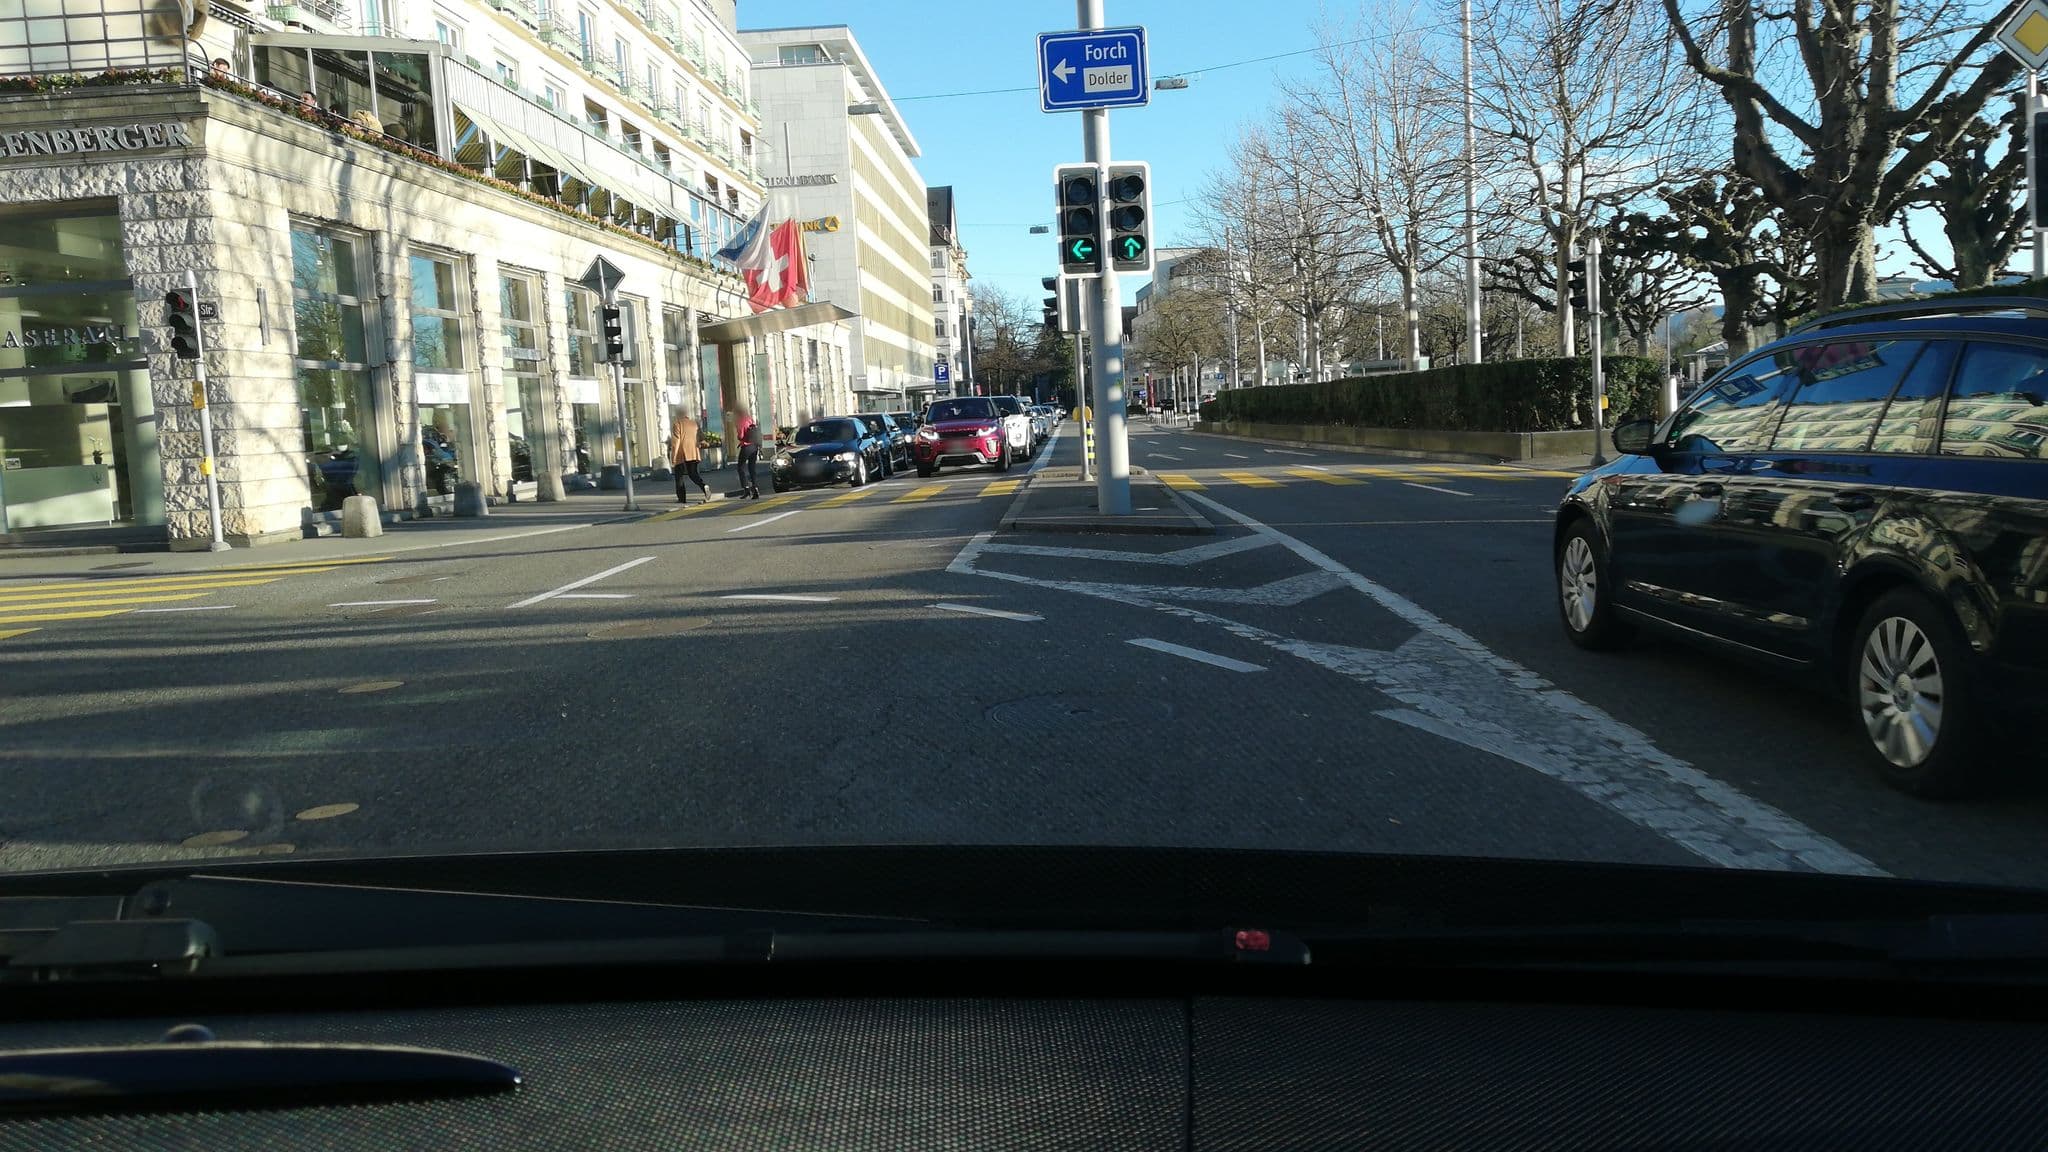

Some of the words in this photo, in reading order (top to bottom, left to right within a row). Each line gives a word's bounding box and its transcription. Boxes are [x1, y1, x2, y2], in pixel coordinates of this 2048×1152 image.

[1085, 41, 1127, 61] Forch
[1088, 71, 1128, 86] Dolder
[0, 122, 192, 157] ENBERGER
[938, 366, 946, 376] P
